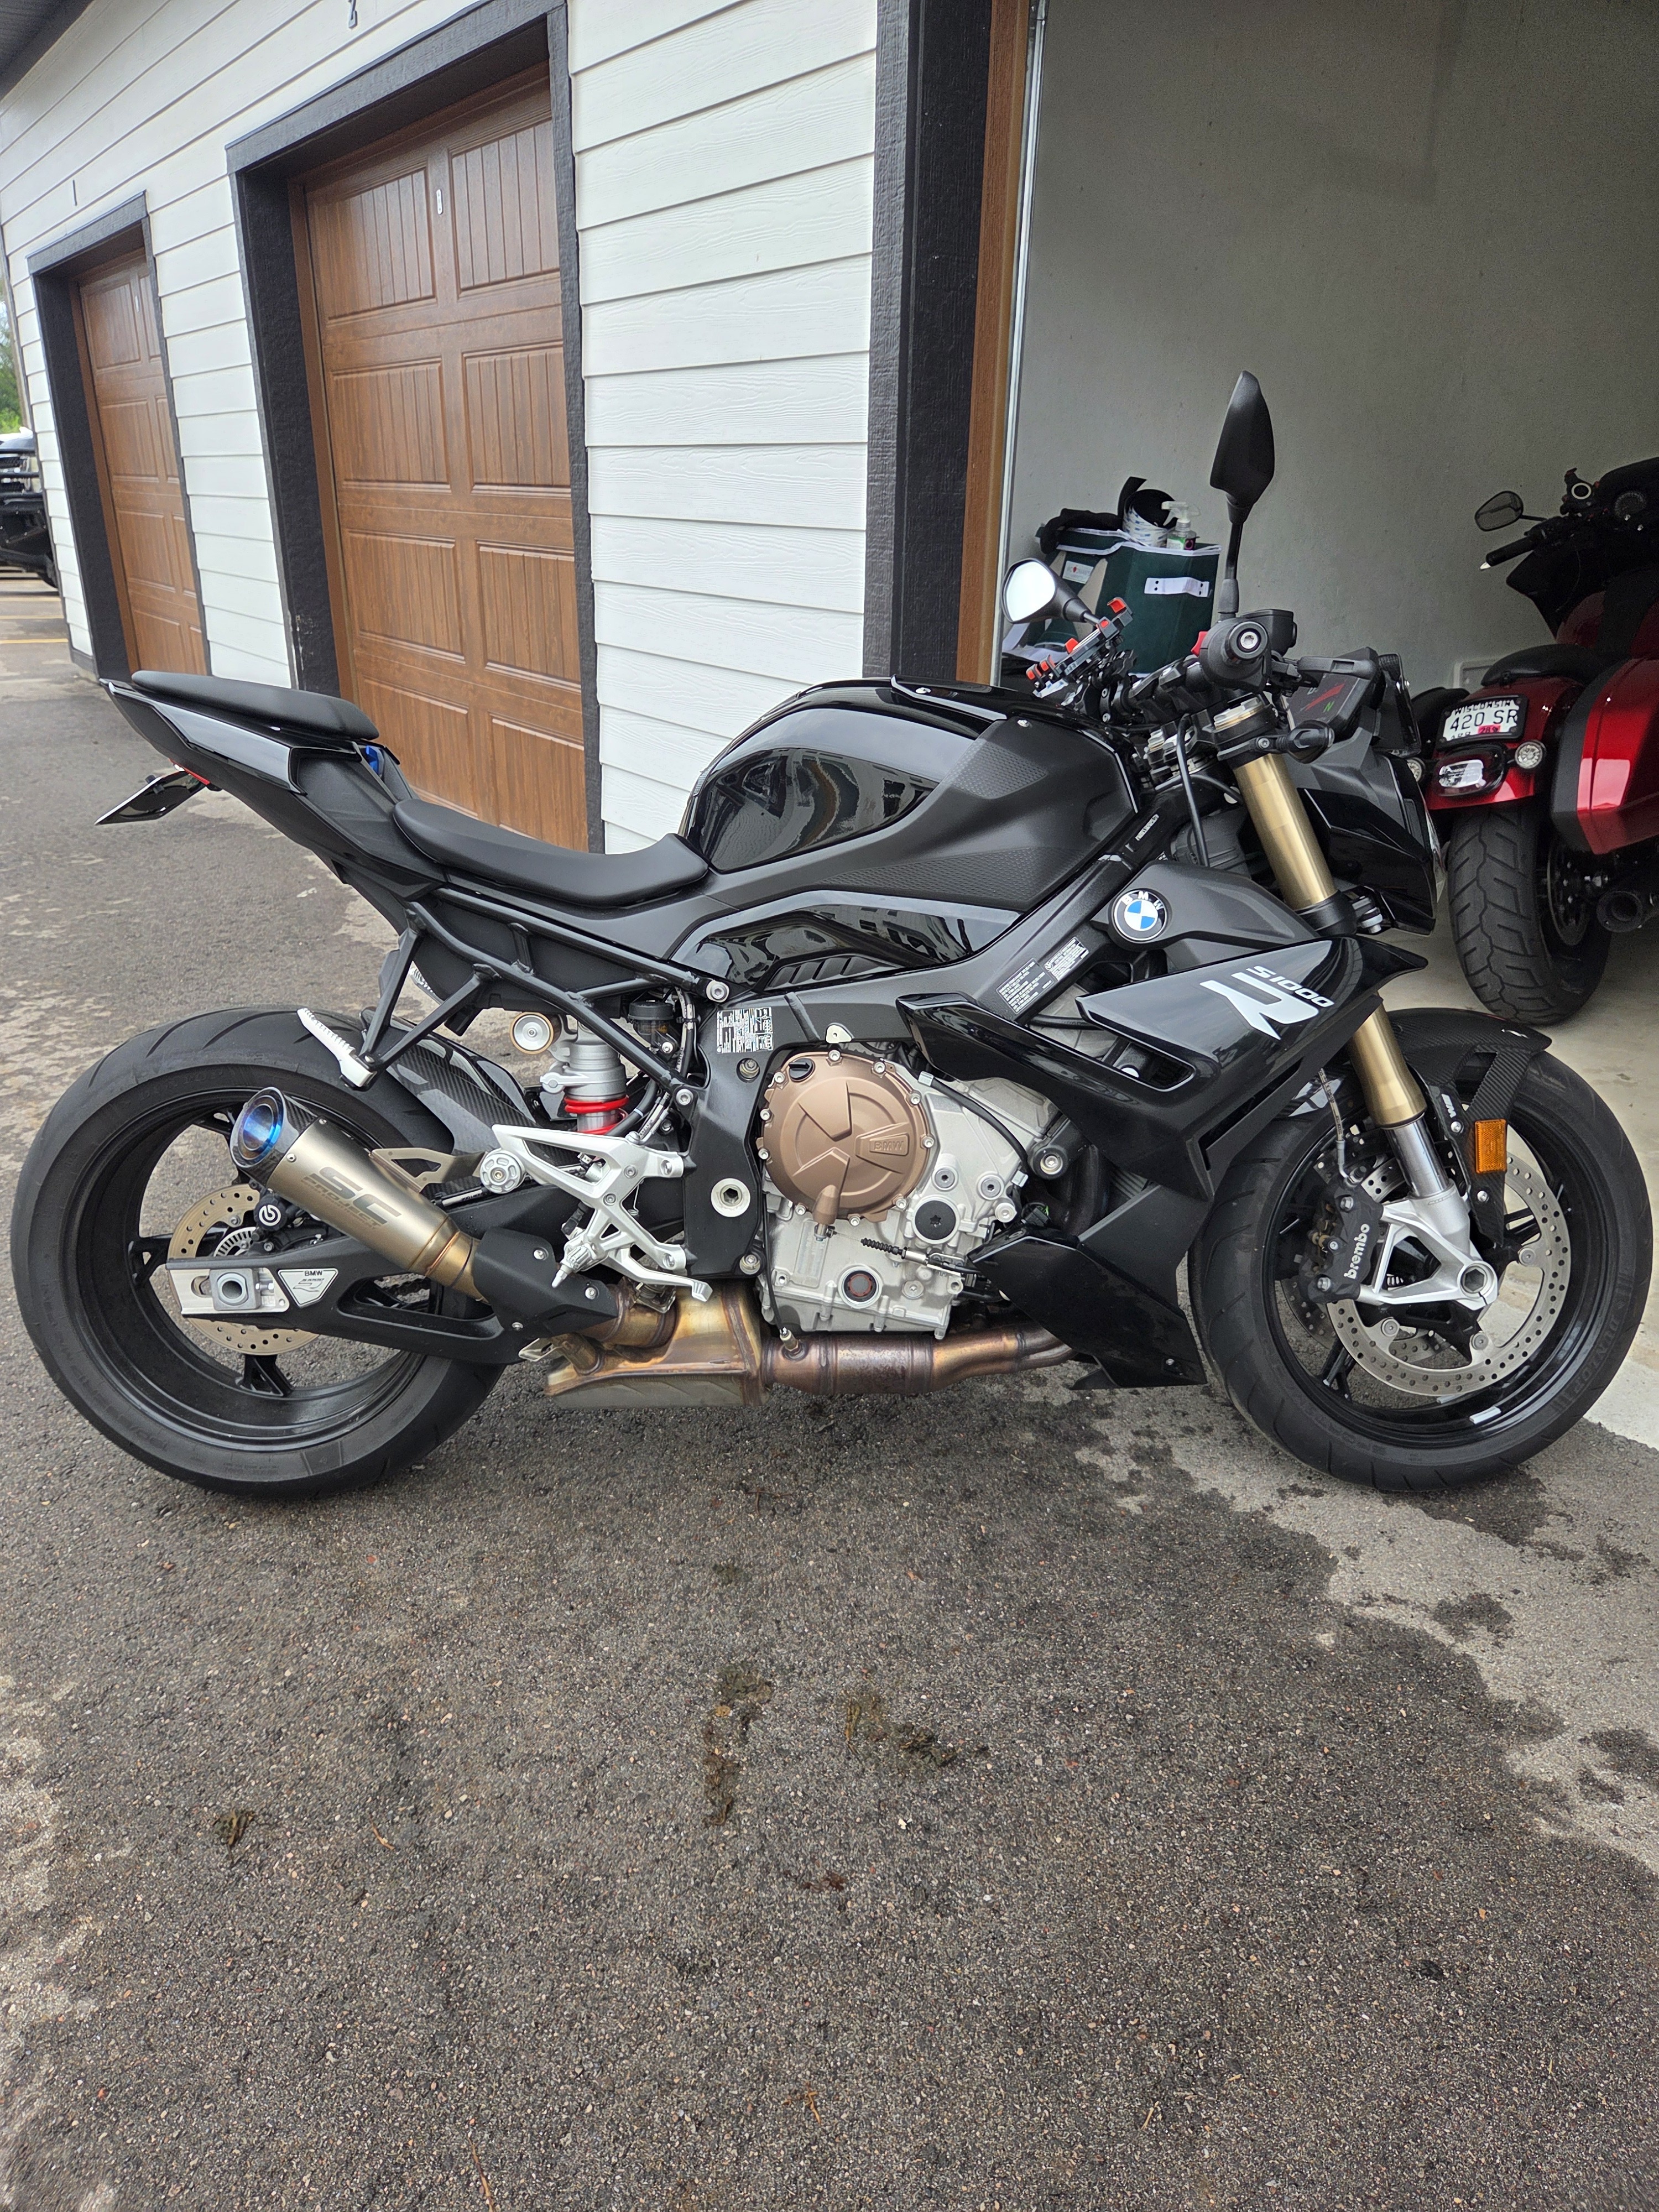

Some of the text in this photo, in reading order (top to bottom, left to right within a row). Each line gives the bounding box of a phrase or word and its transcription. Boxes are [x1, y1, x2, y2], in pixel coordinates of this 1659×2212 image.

[1450, 712, 1485, 732] 420
[1121, 891, 1164, 910] BMW
[1245, 966, 1335, 1008] S1000
[874, 1140, 904, 1151] BMW
[301, 1175, 381, 1227] PROJECT
[309, 1166, 403, 1225] SC
[1343, 1223, 1370, 1279] brembo
